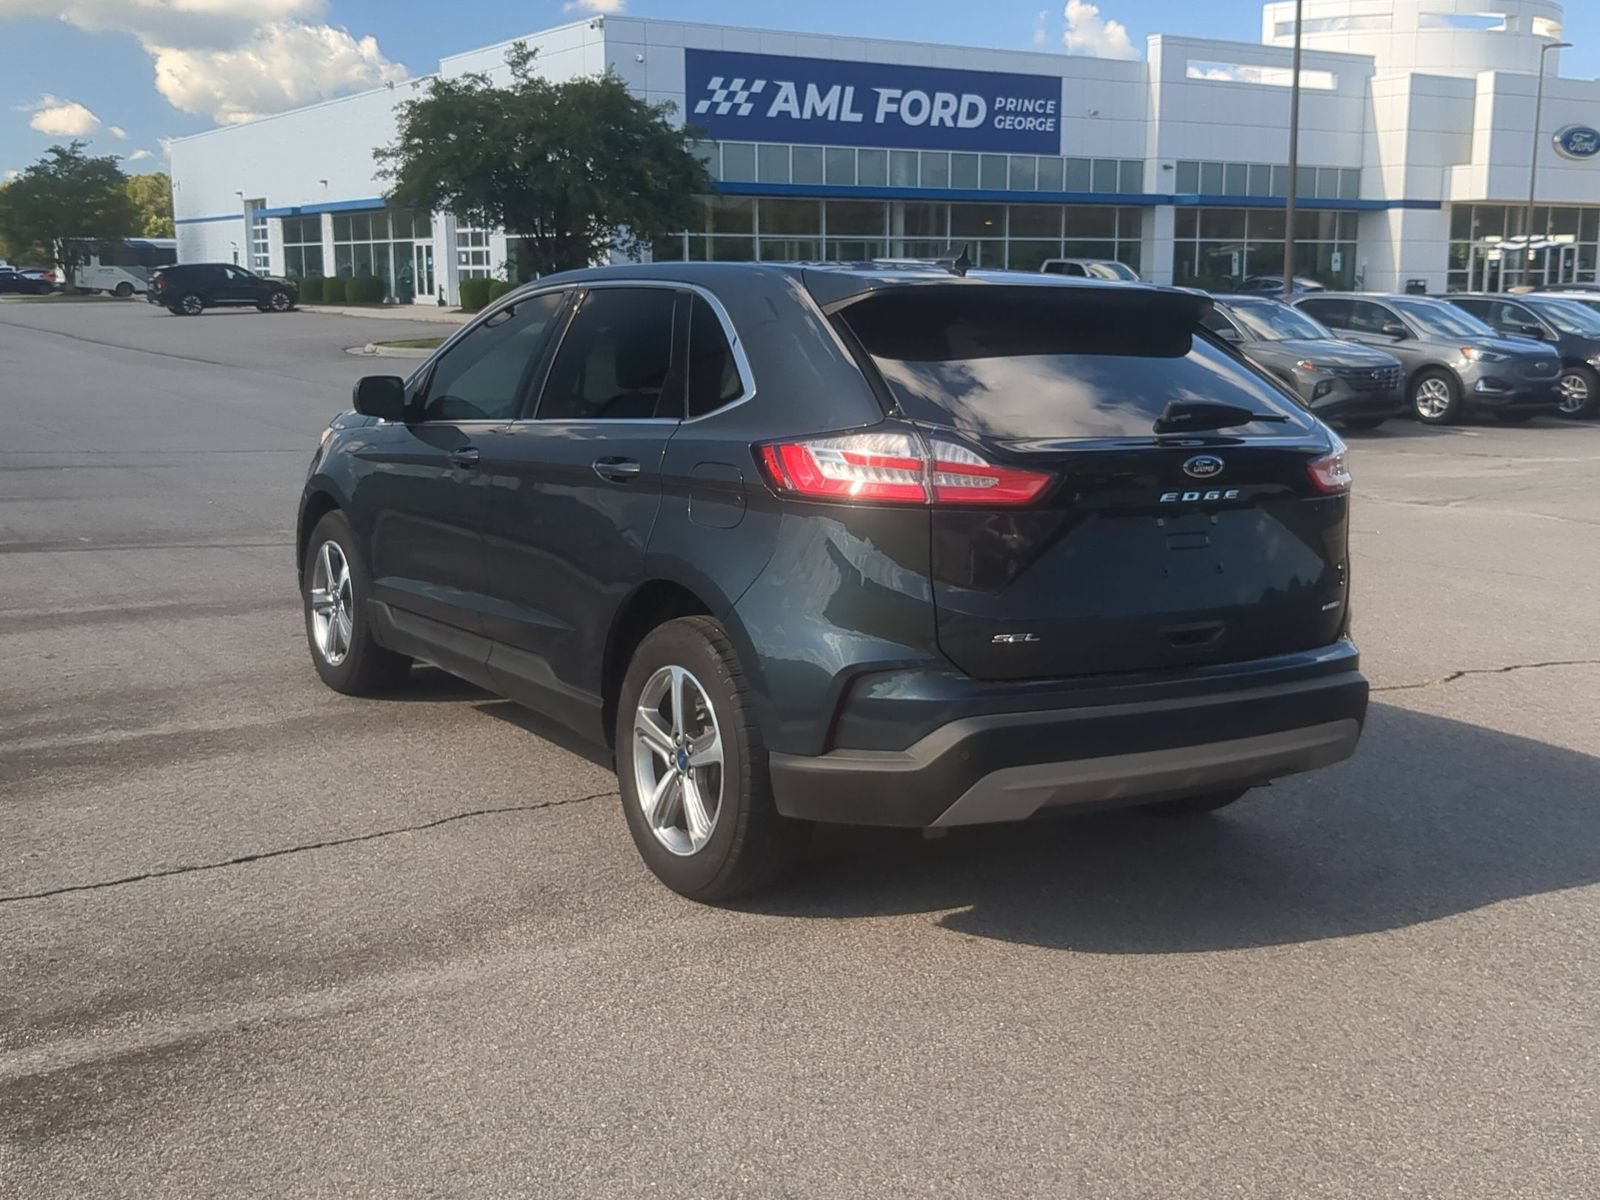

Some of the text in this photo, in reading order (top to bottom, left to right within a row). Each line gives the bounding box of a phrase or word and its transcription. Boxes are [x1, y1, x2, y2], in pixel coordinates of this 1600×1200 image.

[766, 80, 987, 129] AML FORD
[994, 97, 1056, 115] PRINCE
[994, 115, 1056, 132] GEORGE
[1159, 489, 1240, 502] EDGE
[991, 632, 1041, 644] SEL
